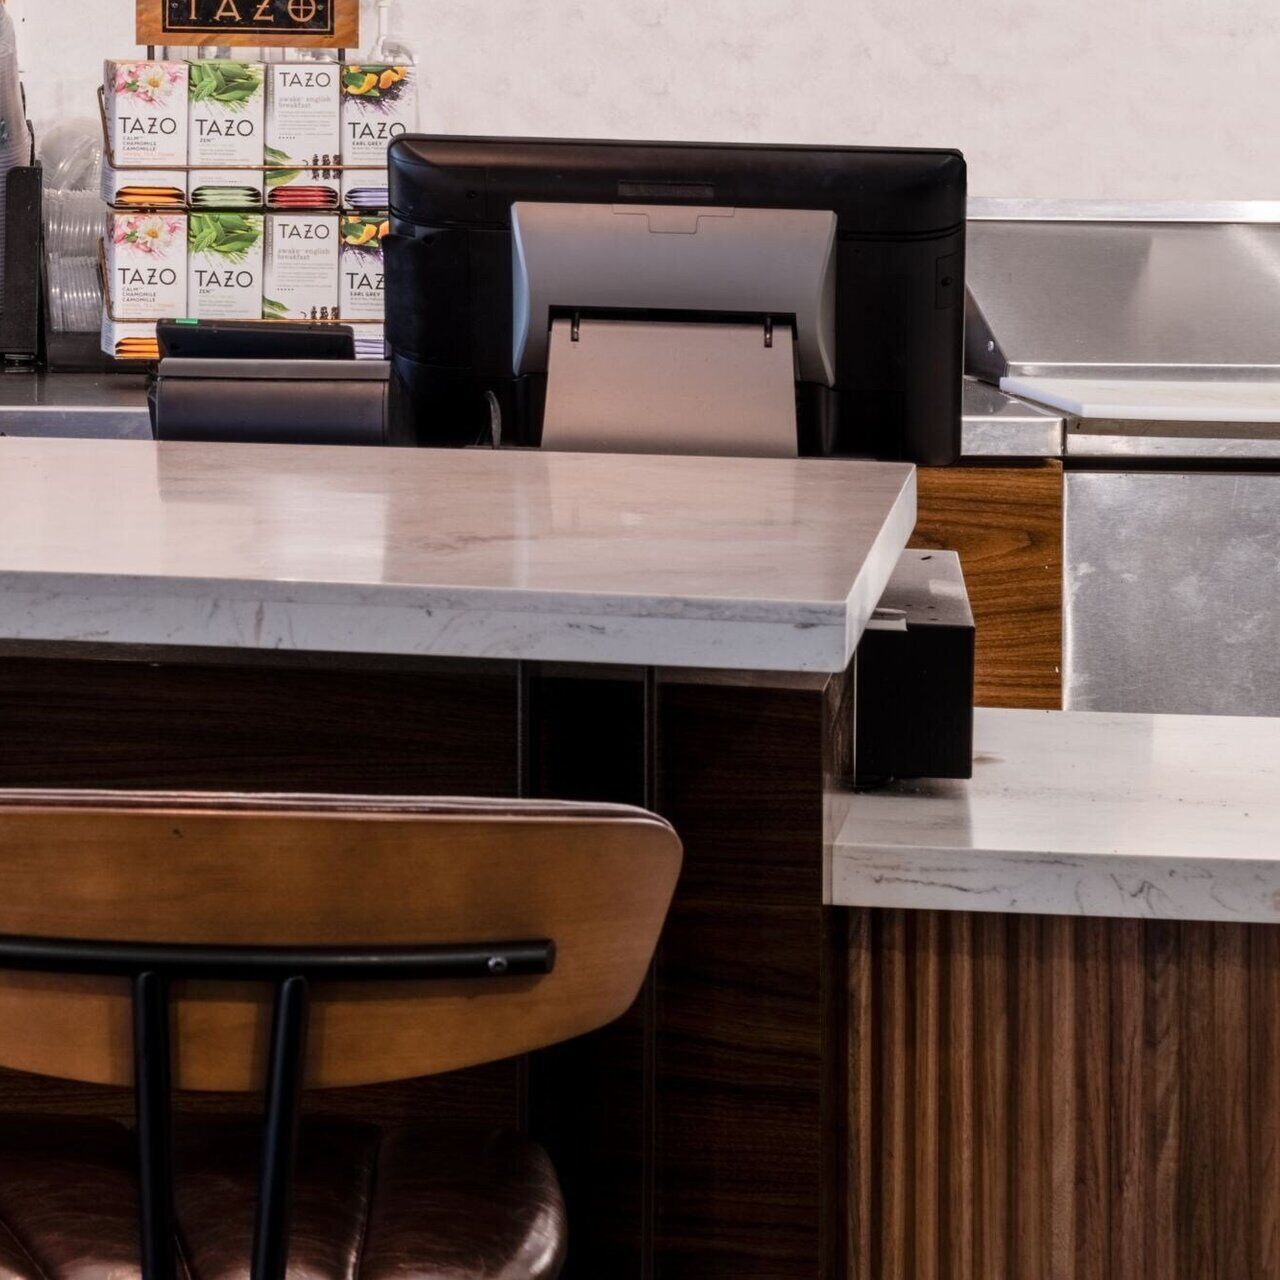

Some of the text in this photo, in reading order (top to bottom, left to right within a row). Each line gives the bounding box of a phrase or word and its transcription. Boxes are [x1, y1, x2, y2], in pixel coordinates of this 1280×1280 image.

[279, 72, 331, 88] TAZO
[118, 116, 177, 135] TAZO
[195, 119, 254, 137] TAZO
[348, 122, 407, 139] TAZO
[278, 223, 330, 240] TAZO
[118, 268, 177, 286] TAZO
[195, 270, 254, 288] TAZO
[346, 272, 384, 289] TAZ
